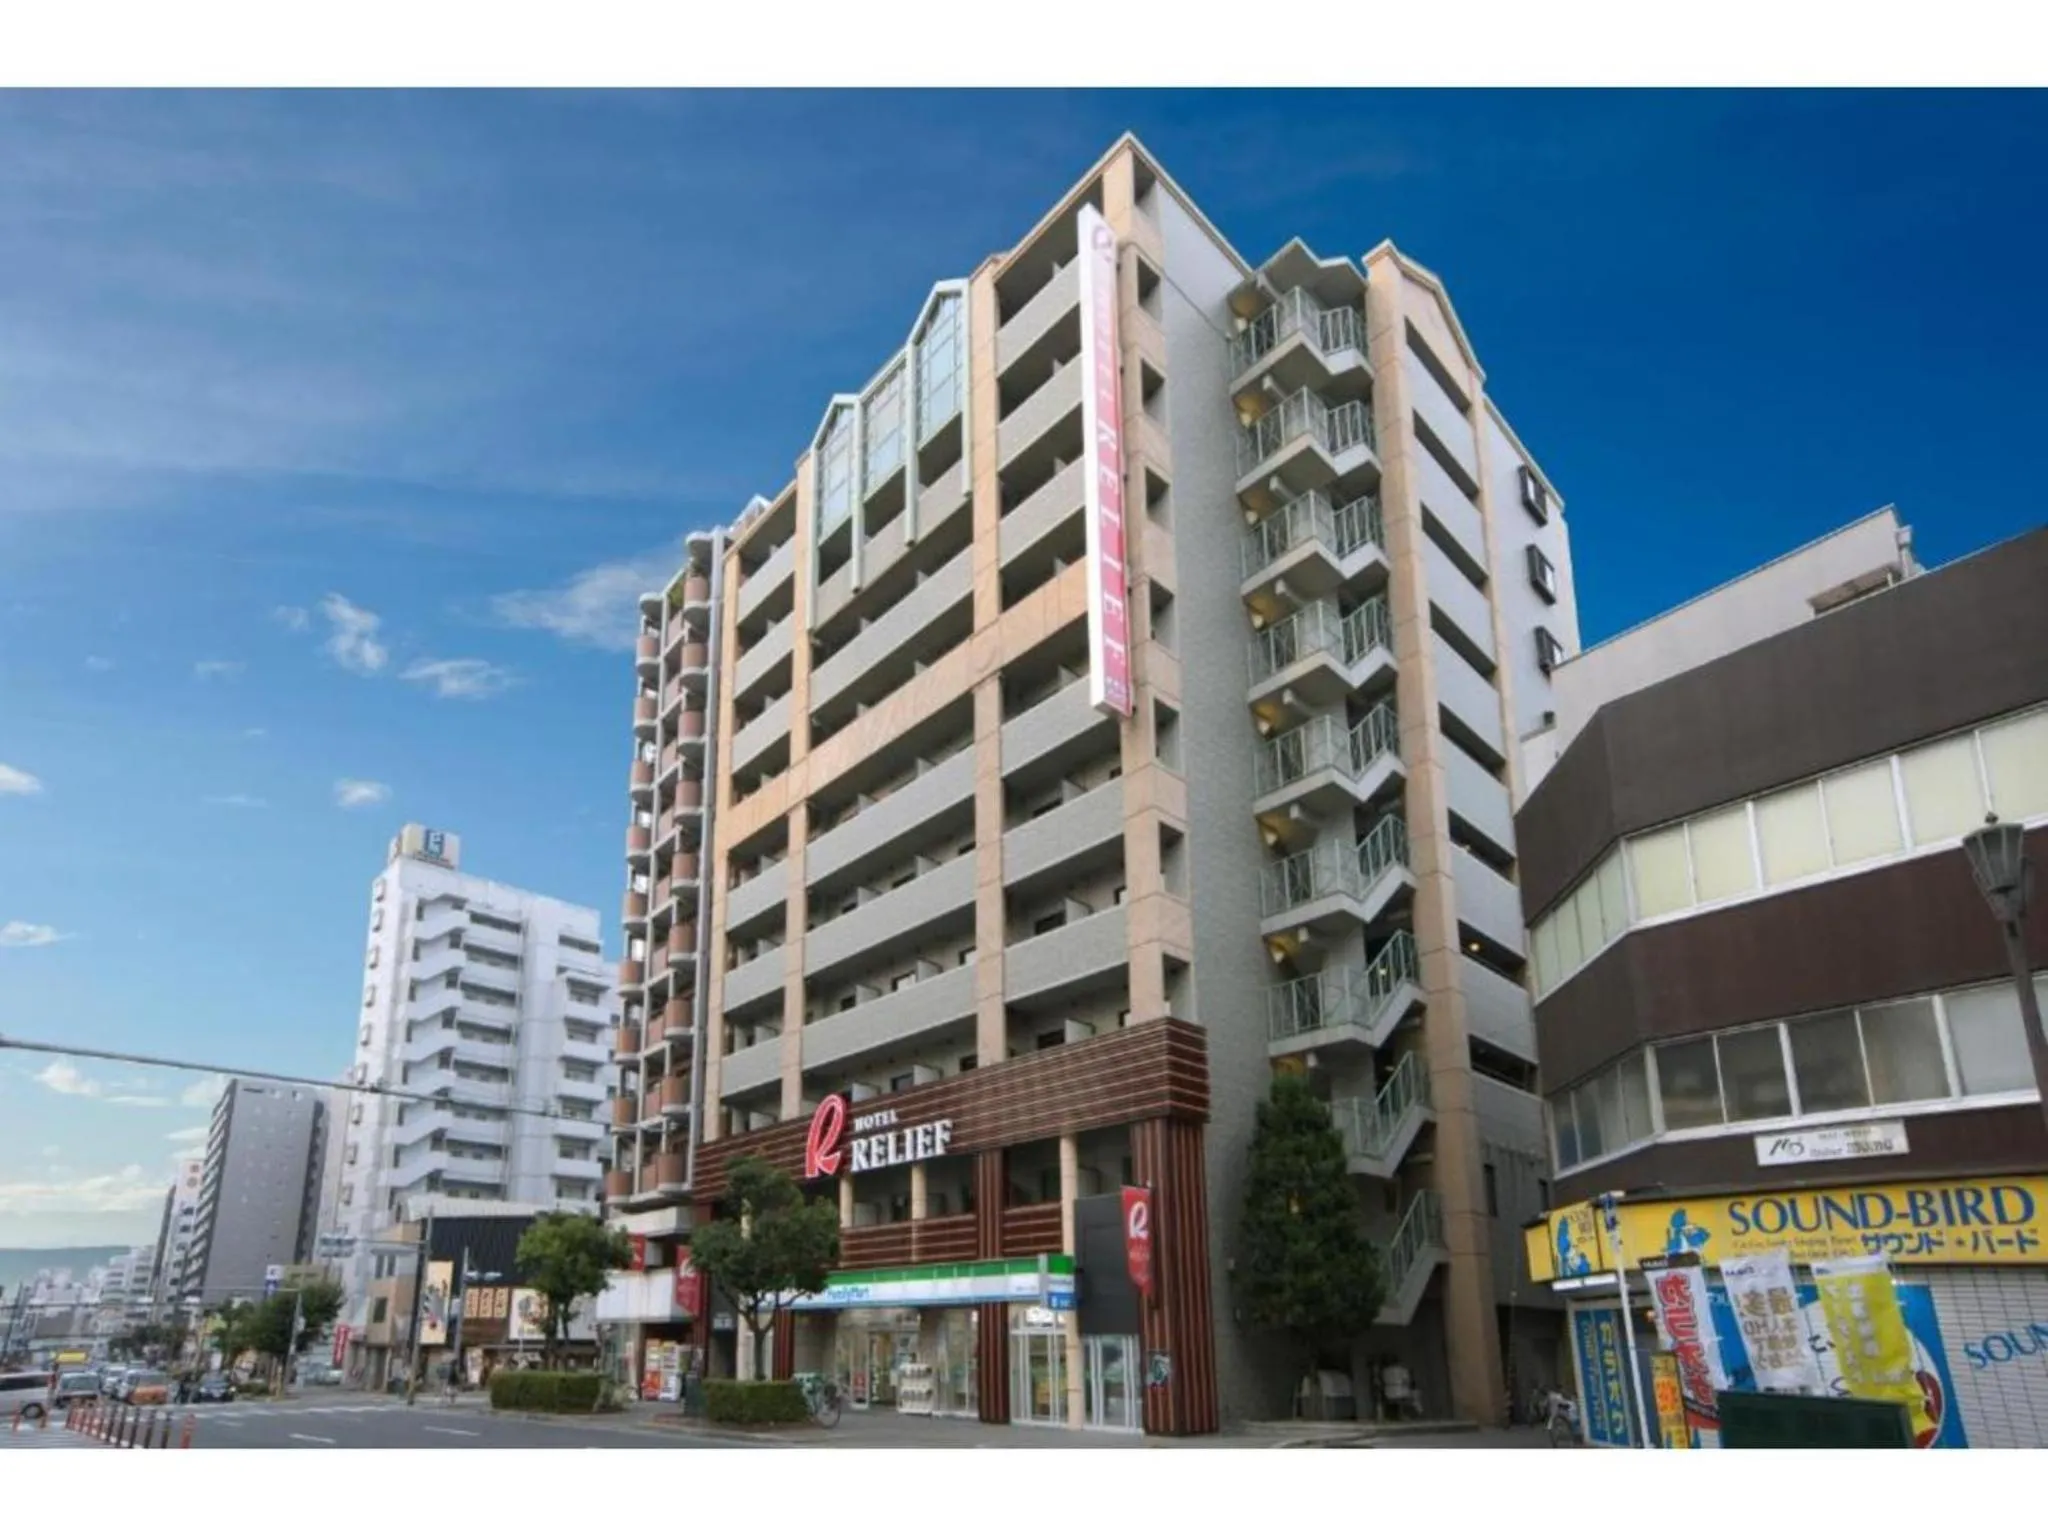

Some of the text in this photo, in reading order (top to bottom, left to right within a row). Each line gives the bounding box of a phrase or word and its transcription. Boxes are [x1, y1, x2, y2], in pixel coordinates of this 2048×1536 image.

[1098, 415, 1125, 667] RELIEF
[850, 1118, 953, 1173] RELIEF
[854, 1108, 899, 1132] HOTEL
[1728, 1184, 2036, 1237] SOUND-BIRD
